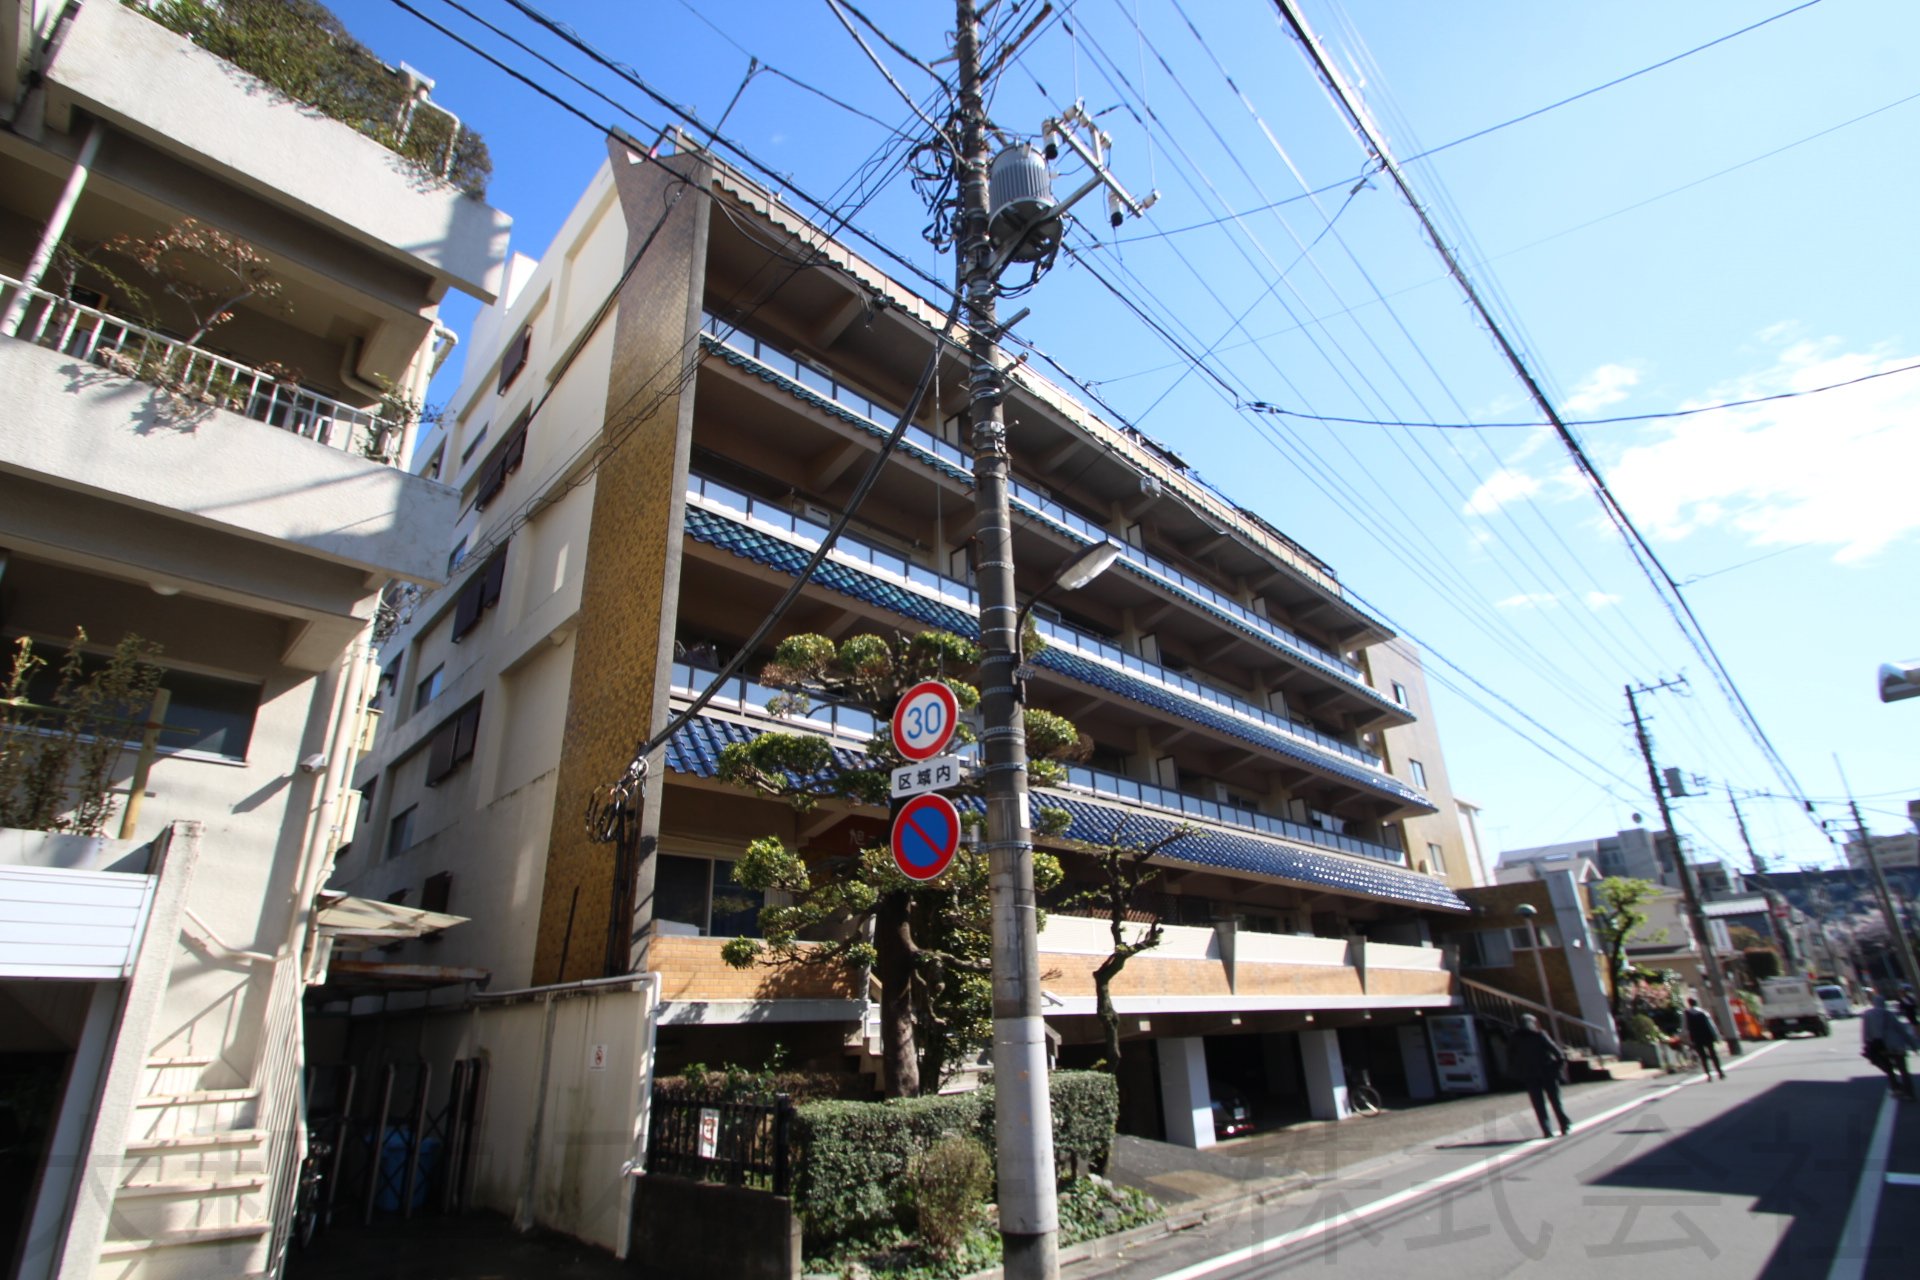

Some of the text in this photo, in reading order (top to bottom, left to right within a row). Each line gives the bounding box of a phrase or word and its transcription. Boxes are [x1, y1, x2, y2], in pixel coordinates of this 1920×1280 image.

[907, 702, 941, 739] 30
[898, 764, 952, 791] 区域内
